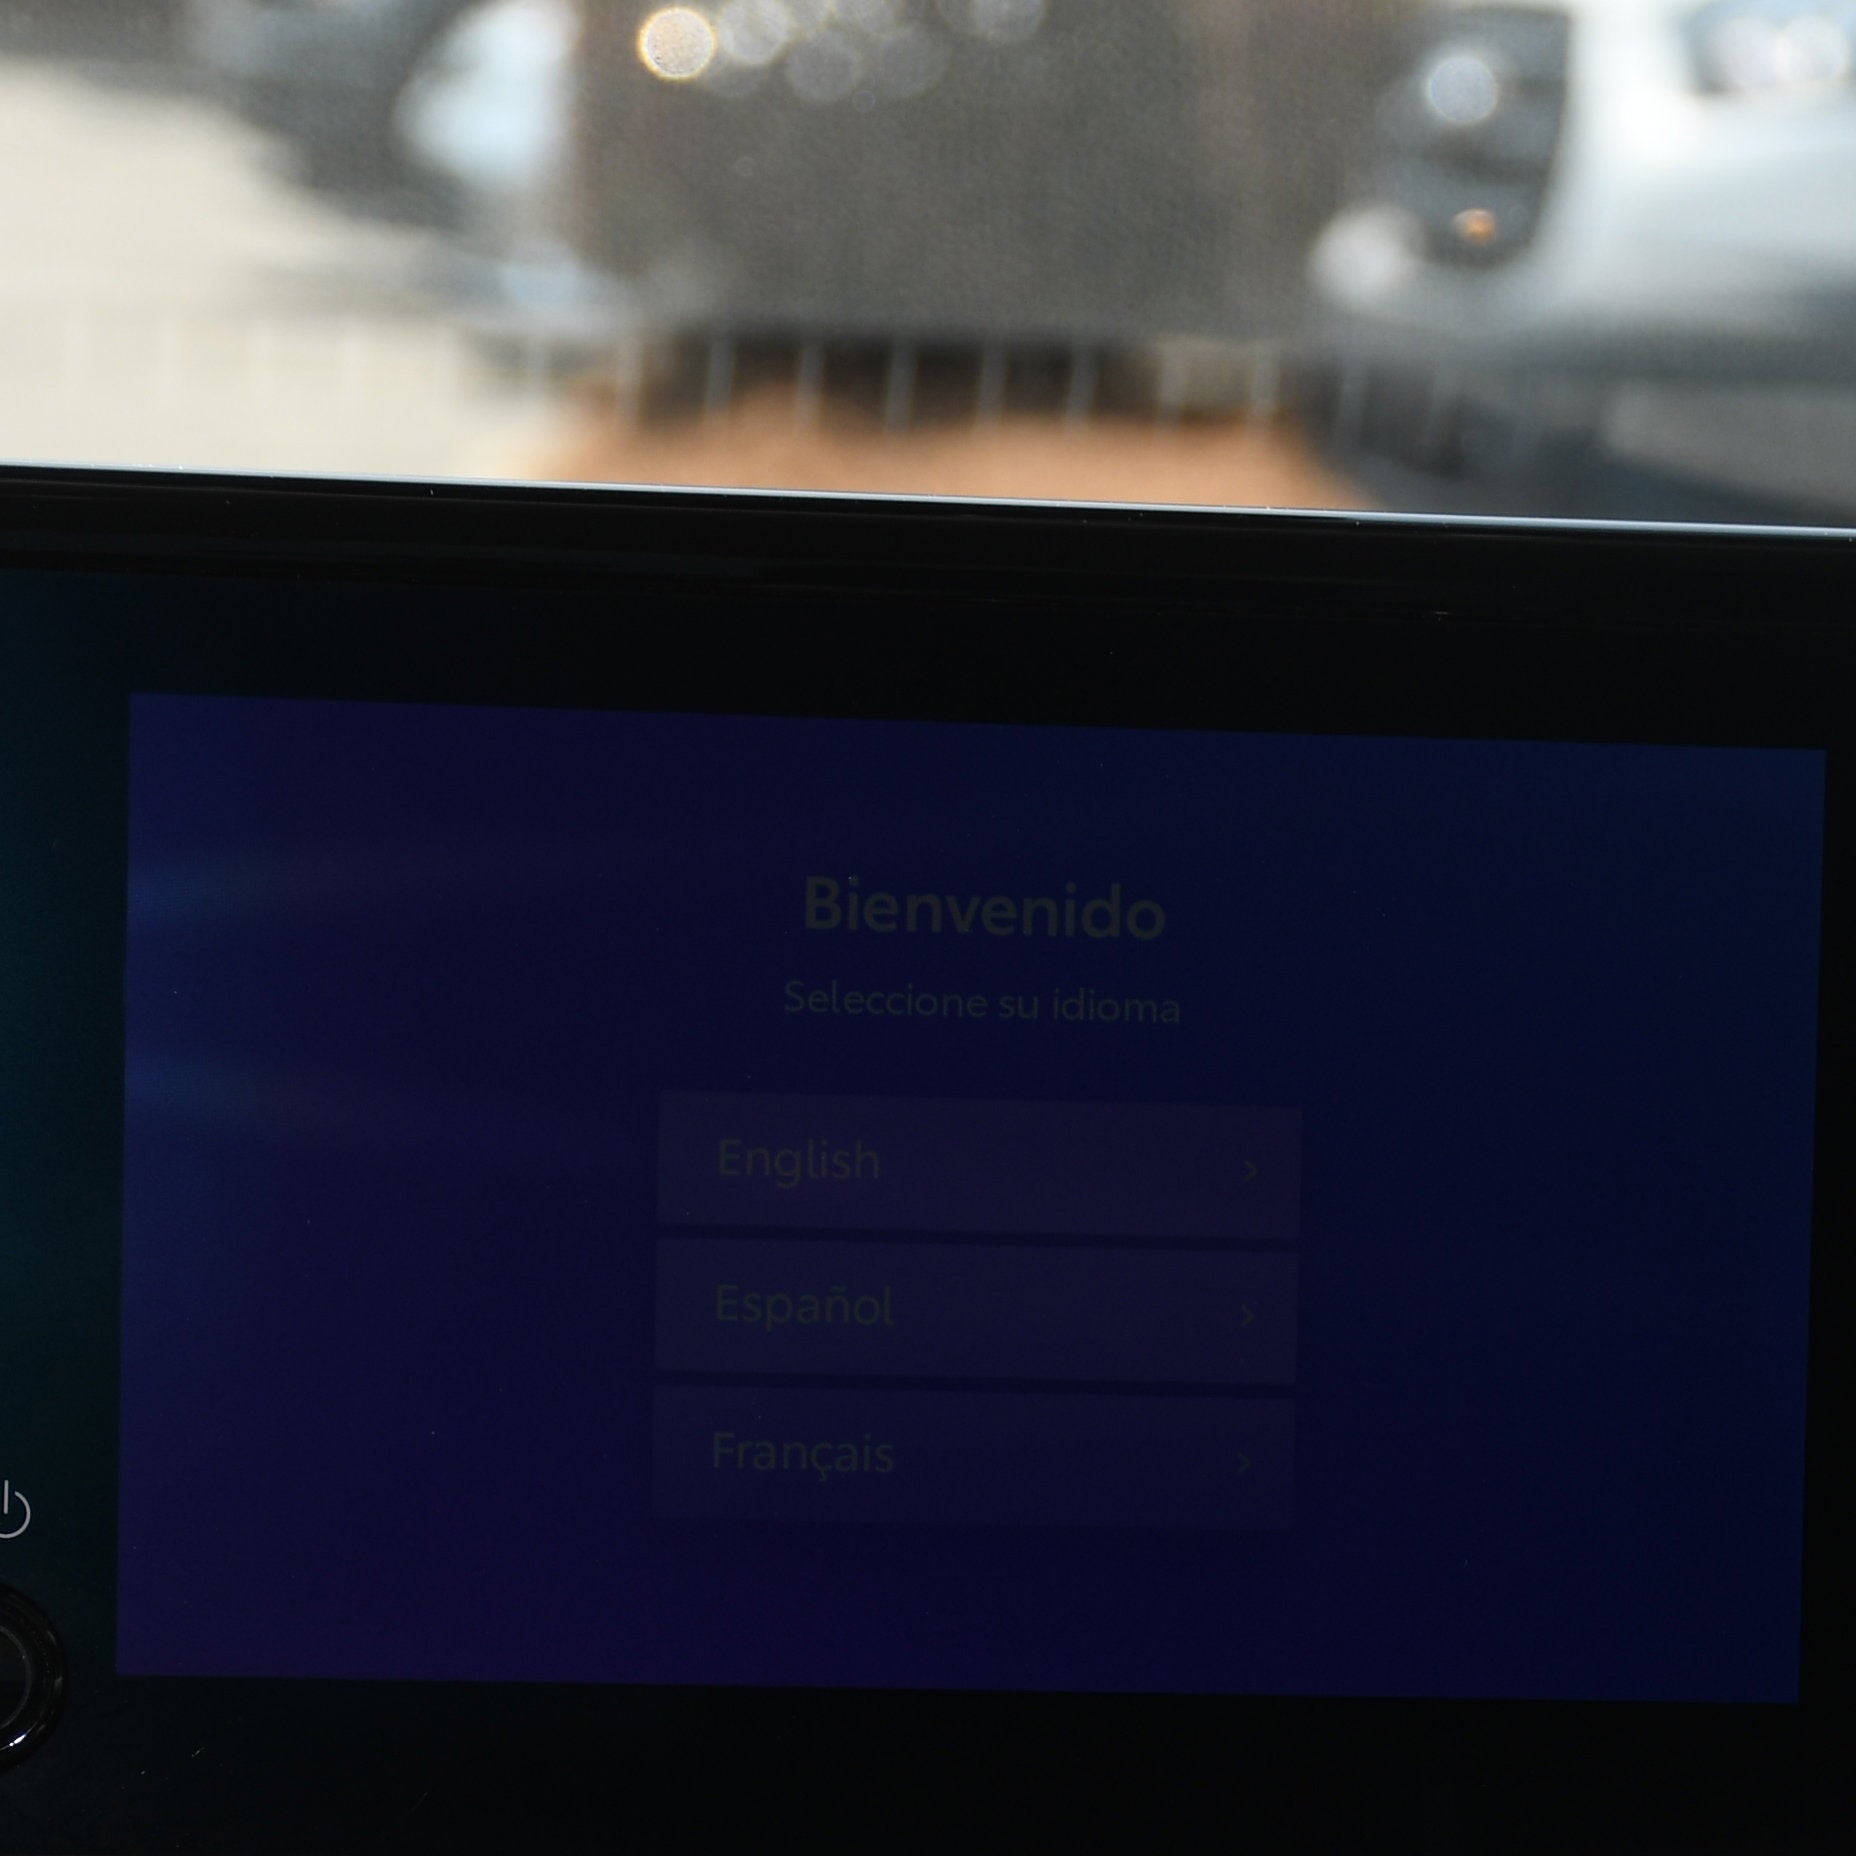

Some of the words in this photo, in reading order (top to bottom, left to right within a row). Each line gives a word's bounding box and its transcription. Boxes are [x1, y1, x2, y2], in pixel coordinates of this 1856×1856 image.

[805, 876, 1166, 940] Bienvenido
[784, 980, 989, 1019] Seleccione
[998, 994, 1038, 1020] su
[1054, 987, 1181, 1026] idioma
[718, 1138, 880, 1188] English
[715, 1284, 896, 1333] Español
[712, 1431, 896, 1483] Français
